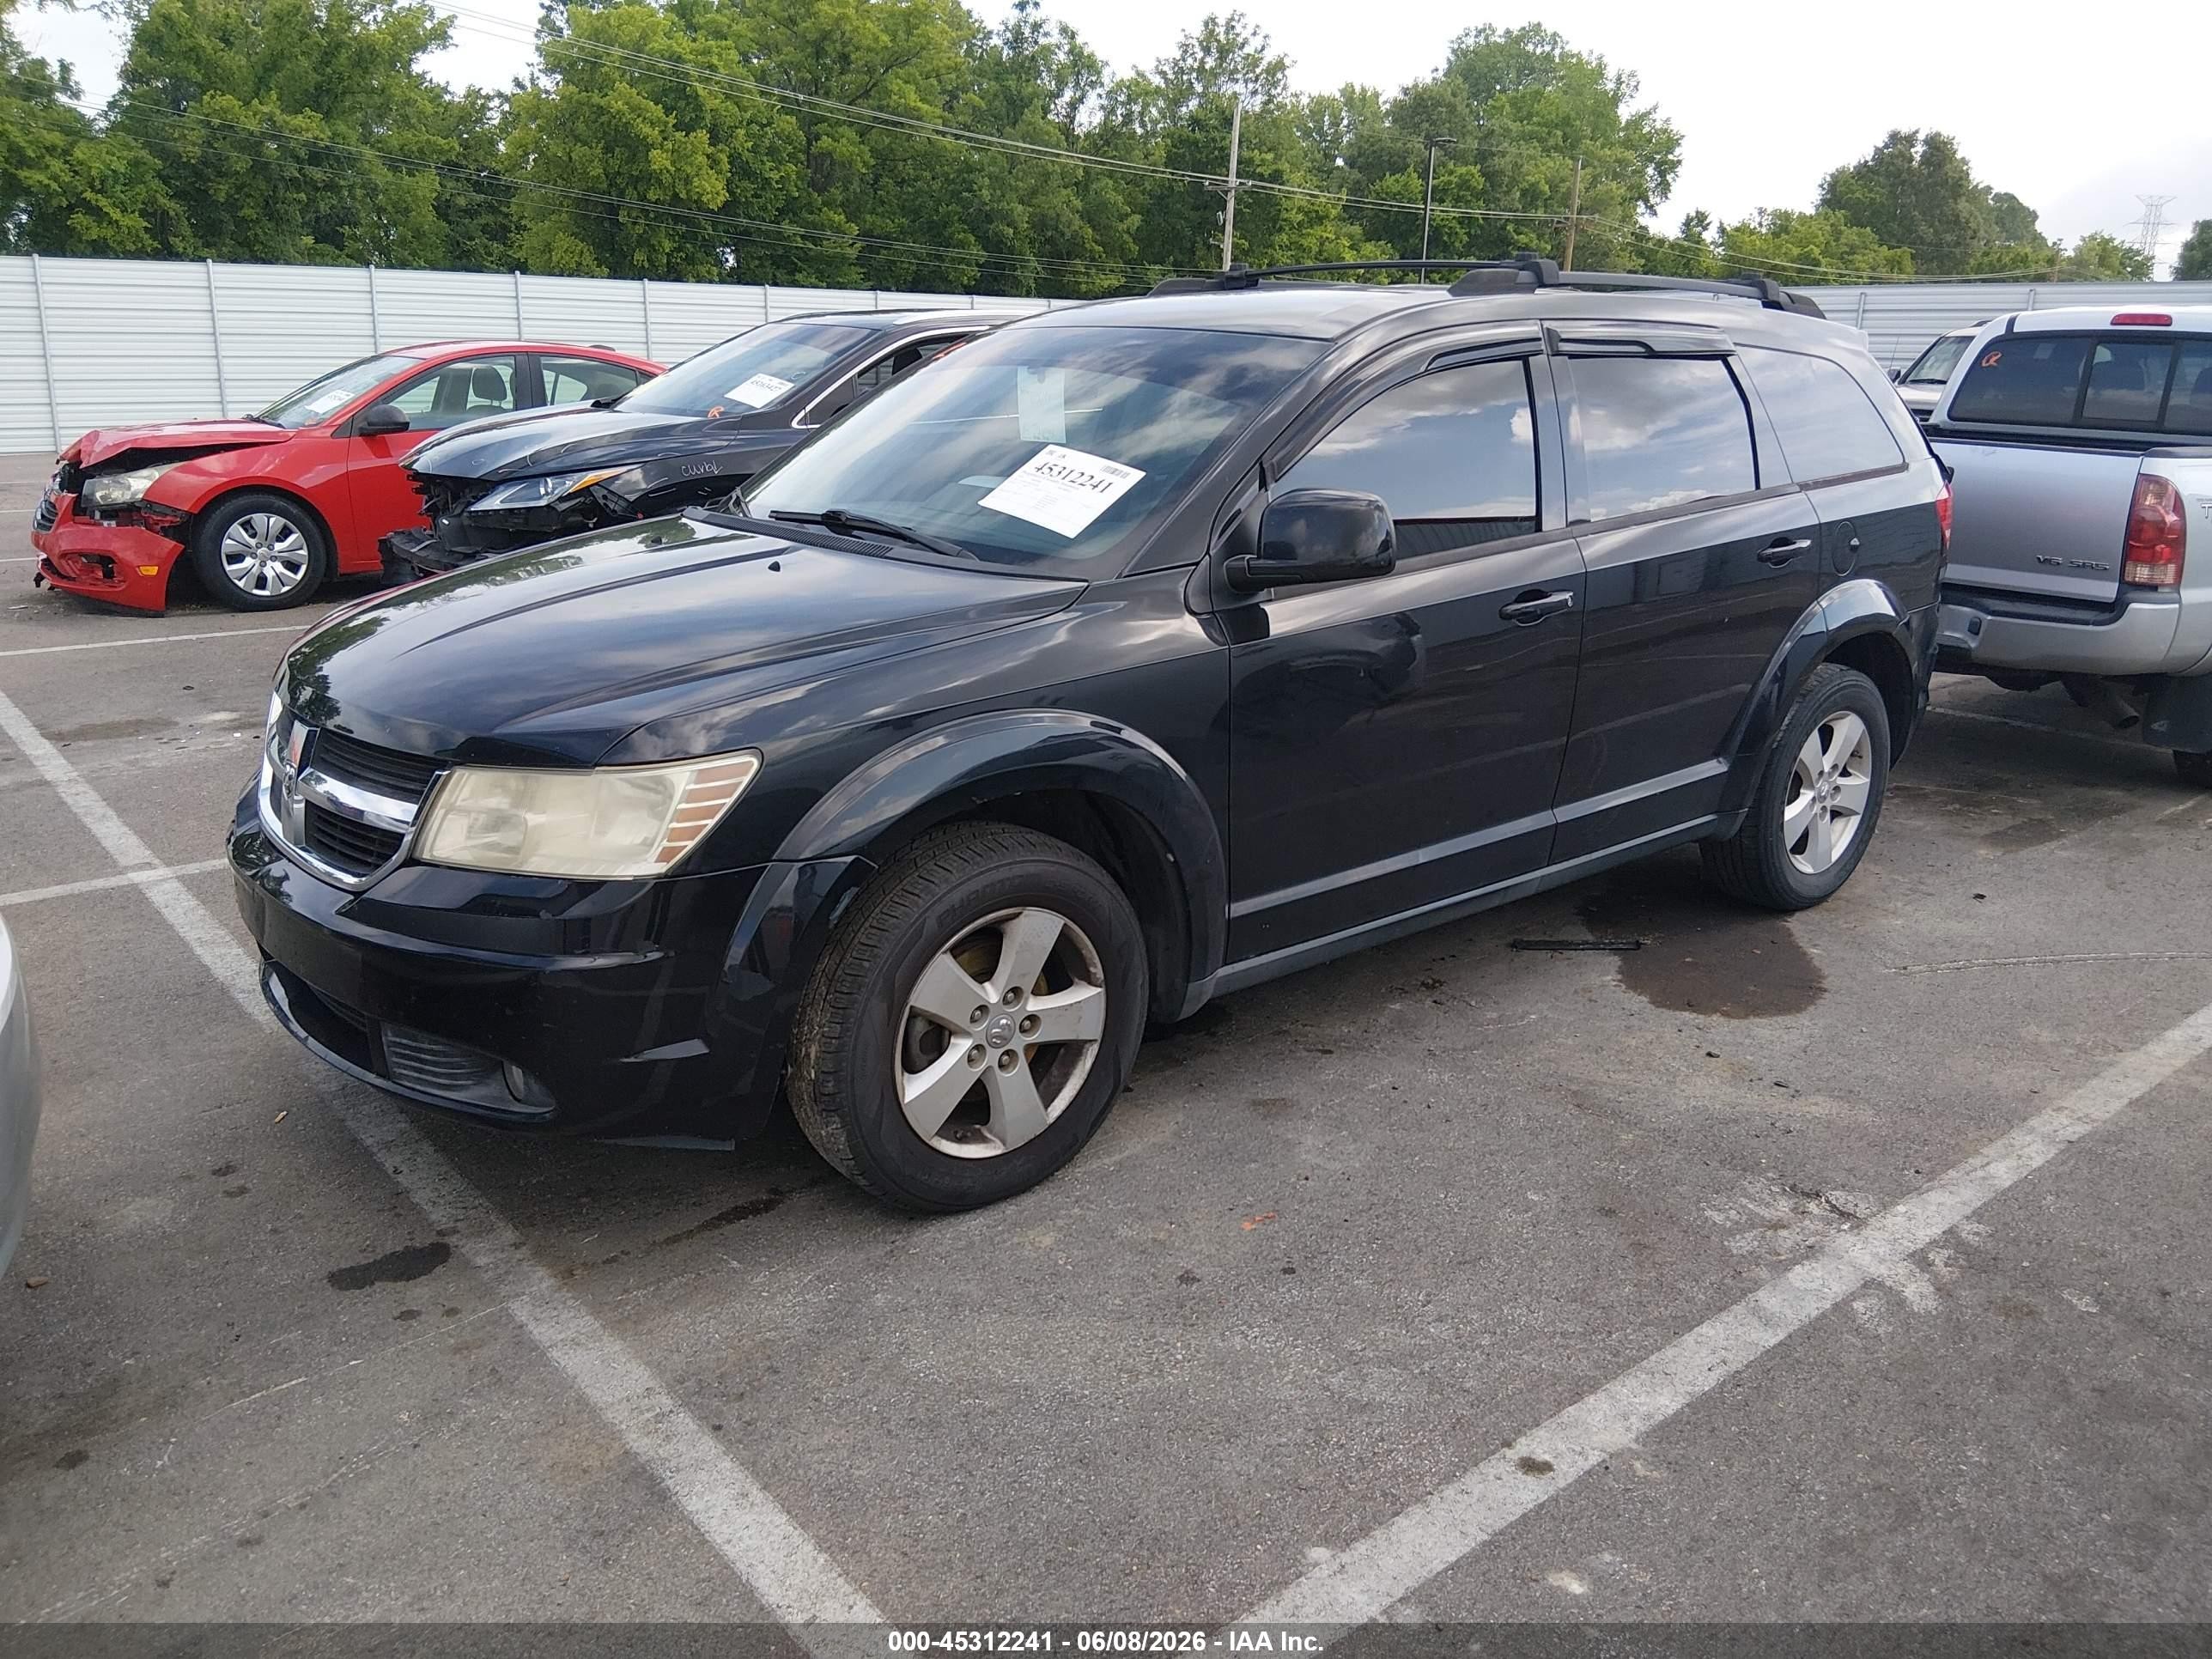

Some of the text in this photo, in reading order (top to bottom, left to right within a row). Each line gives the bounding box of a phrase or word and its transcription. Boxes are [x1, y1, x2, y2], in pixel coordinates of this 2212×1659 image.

[1034, 461, 1114, 493] 45312241
[2035, 554, 2110, 571] V6 SR5
